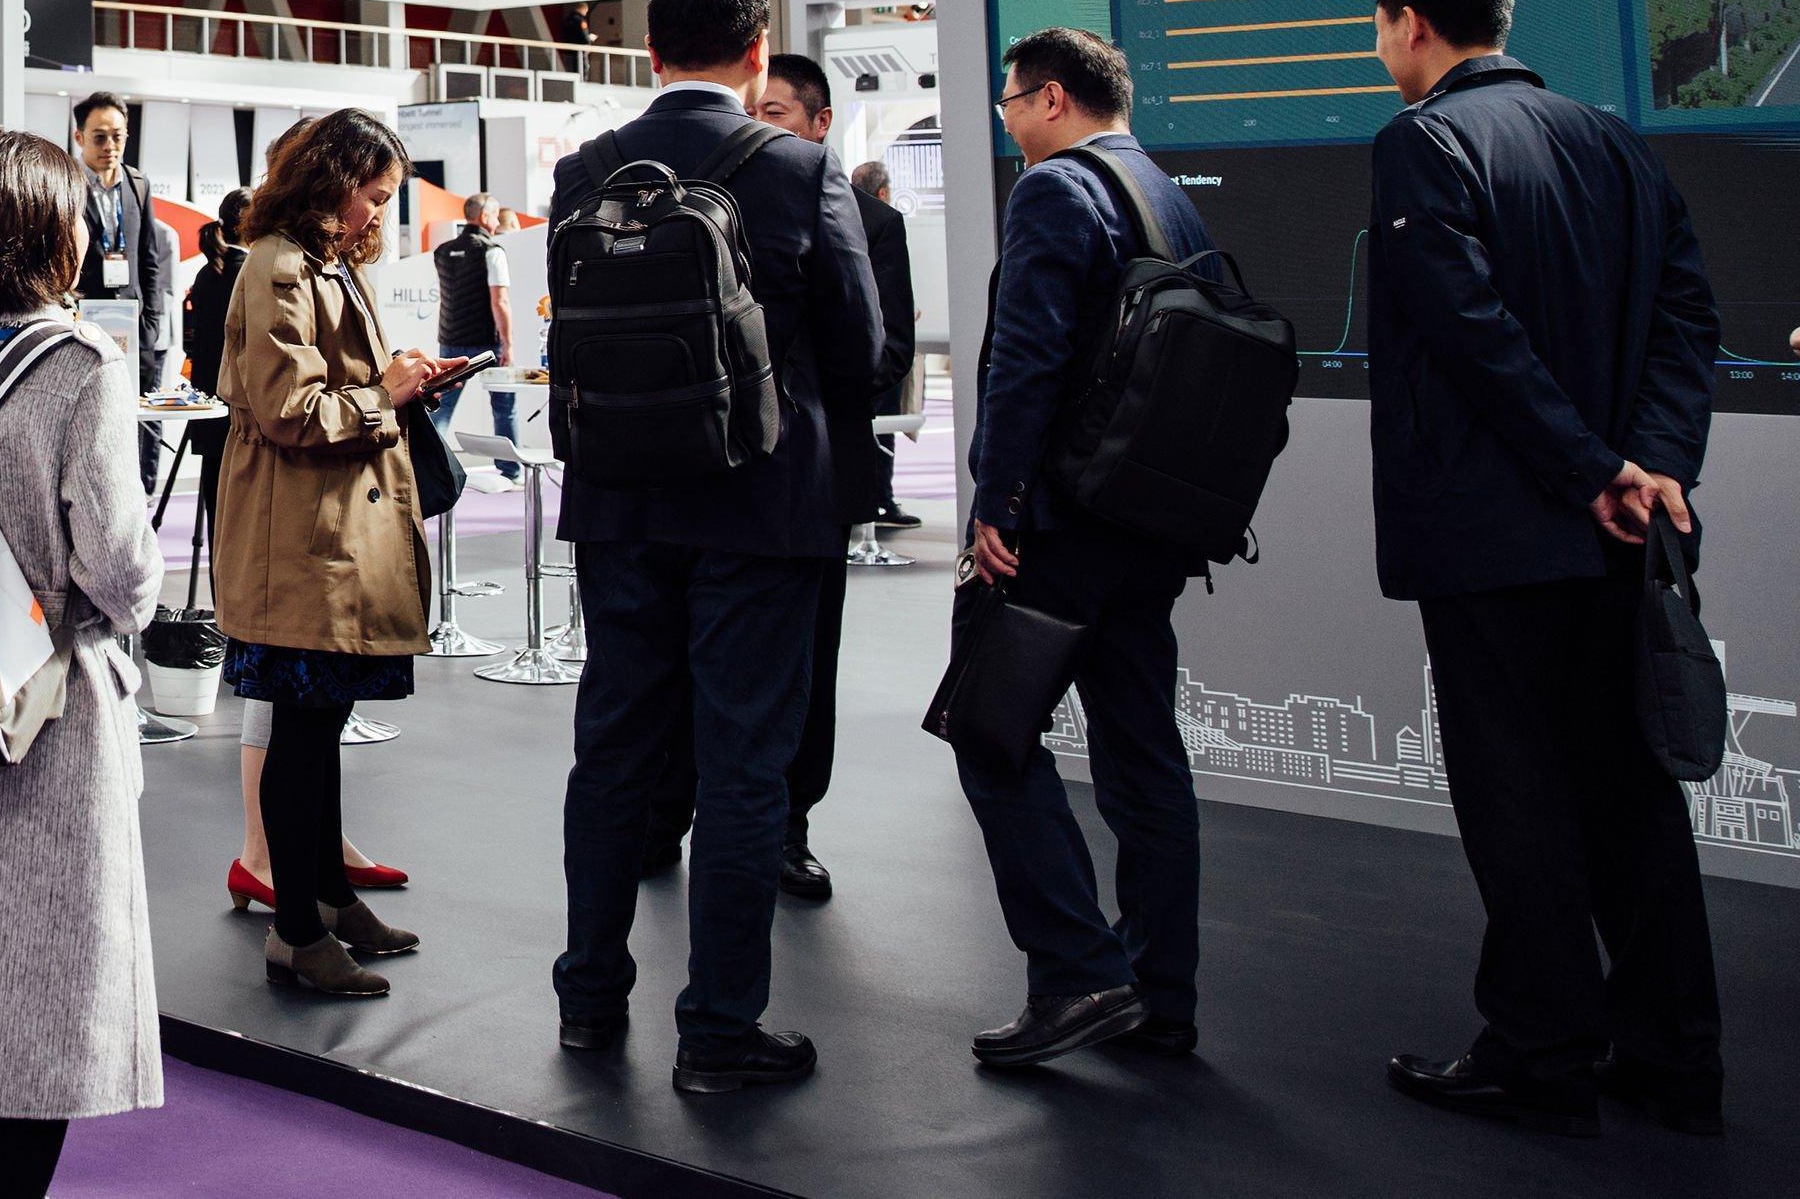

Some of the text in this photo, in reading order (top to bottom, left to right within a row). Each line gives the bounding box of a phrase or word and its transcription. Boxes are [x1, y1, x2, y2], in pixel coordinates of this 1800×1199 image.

[1168, 122, 1174, 130] 0
[1181, 174, 1222, 187] Tendency
[1322, 359, 1342, 369] 04:00
[1729, 370, 1754, 379] 13:00
